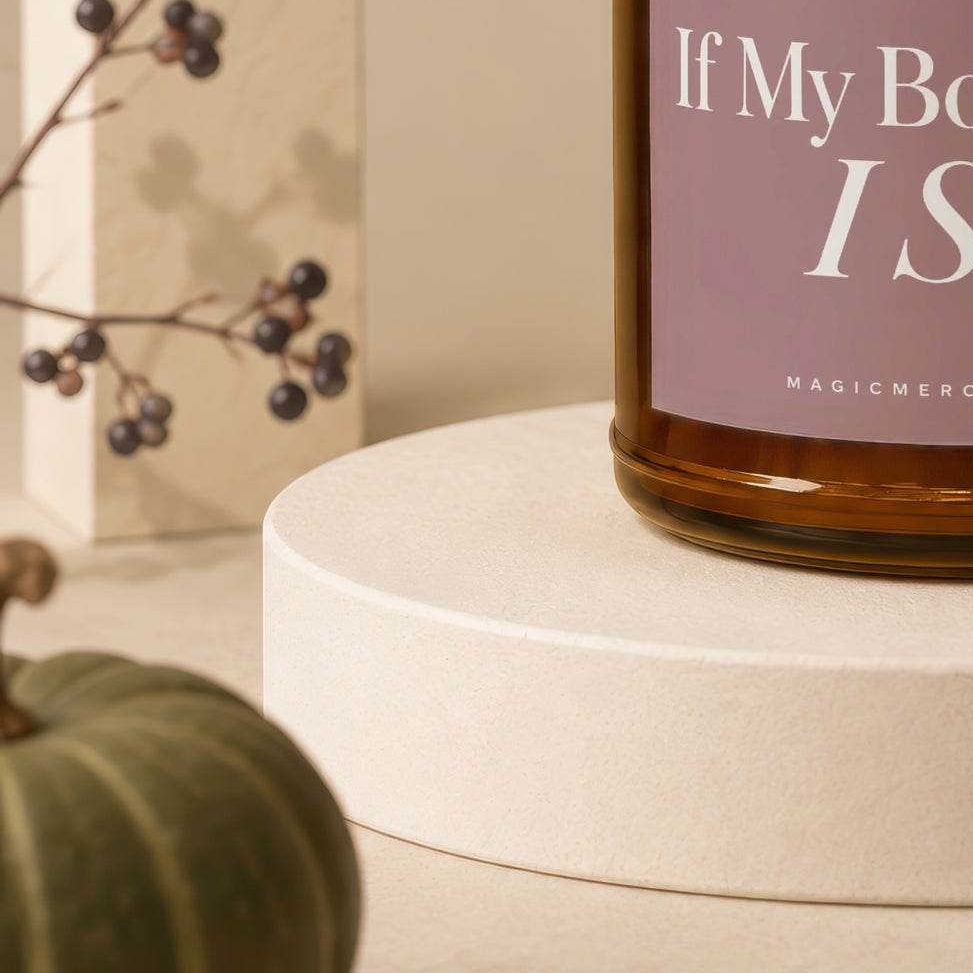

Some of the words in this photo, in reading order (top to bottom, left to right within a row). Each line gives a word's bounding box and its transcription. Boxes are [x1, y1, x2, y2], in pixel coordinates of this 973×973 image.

[675, 26, 723, 112] If
[735, 36, 856, 148] My
[803, 158, 885, 278] I
